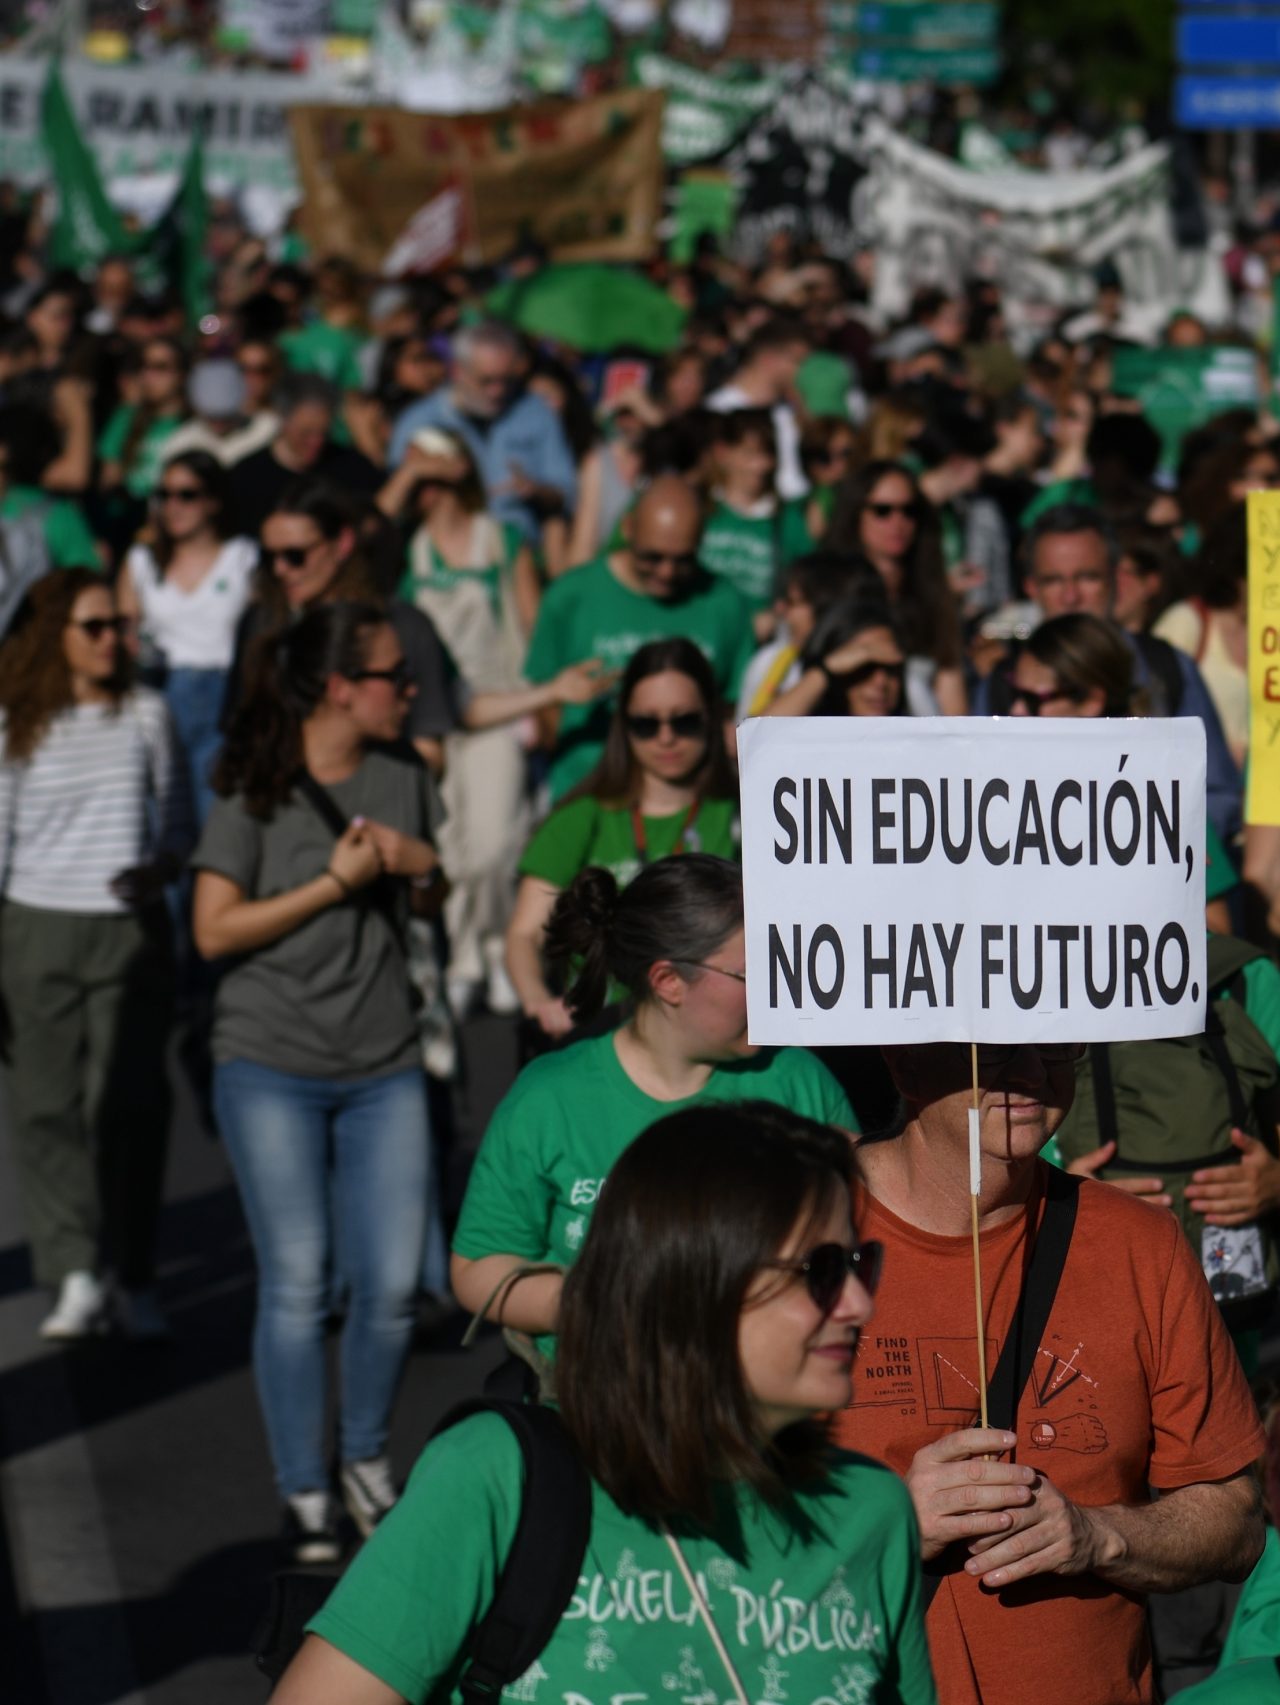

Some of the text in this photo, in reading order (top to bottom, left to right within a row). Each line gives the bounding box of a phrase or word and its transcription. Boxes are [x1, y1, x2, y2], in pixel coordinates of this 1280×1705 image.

[773, 754, 1194, 883] SIN EDUCACIÓN,
[768, 921, 1199, 1010] NO HAY FUTURO.
[876, 1337, 908, 1349] FIND
[884, 1351, 910, 1361] THE
[866, 1365, 912, 1379] NORTH
[561, 1569, 712, 1627] SCUELA
